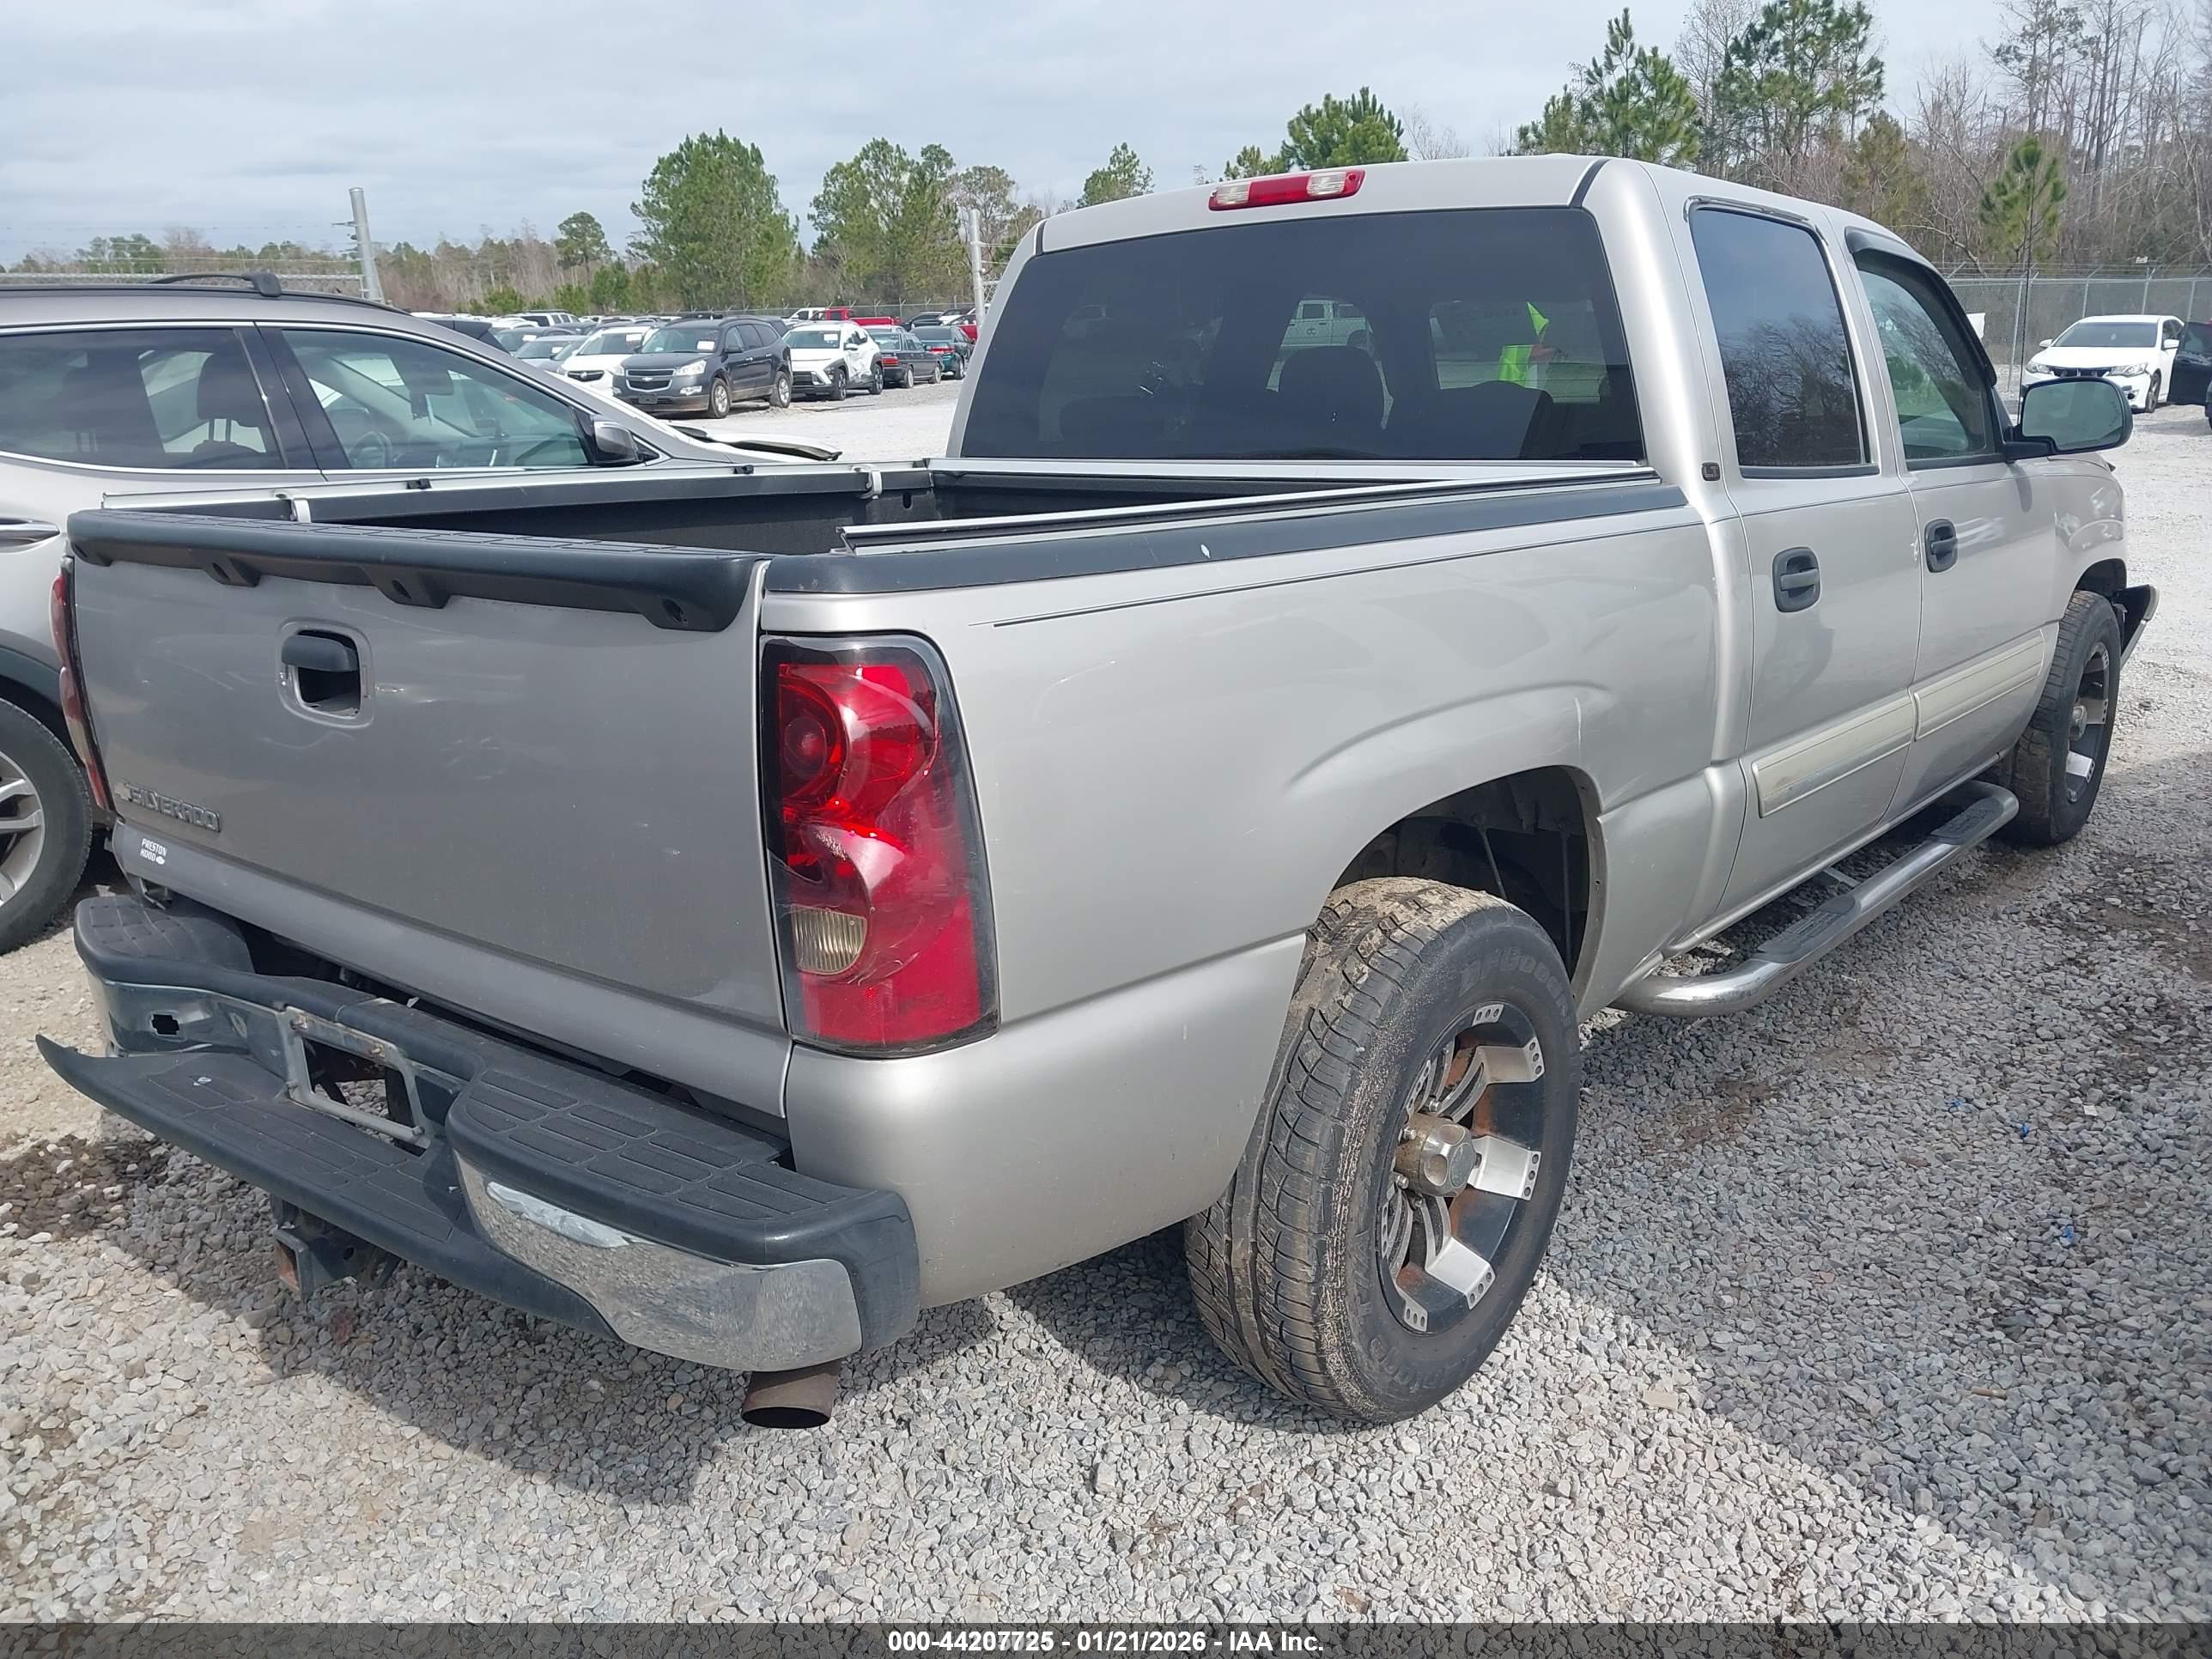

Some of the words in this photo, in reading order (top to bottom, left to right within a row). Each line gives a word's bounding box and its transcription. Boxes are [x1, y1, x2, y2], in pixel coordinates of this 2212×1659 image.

[129, 785, 221, 832] SILVERADO
[139, 848, 156, 862] HOOD
[141, 837, 167, 857] PRESTON
